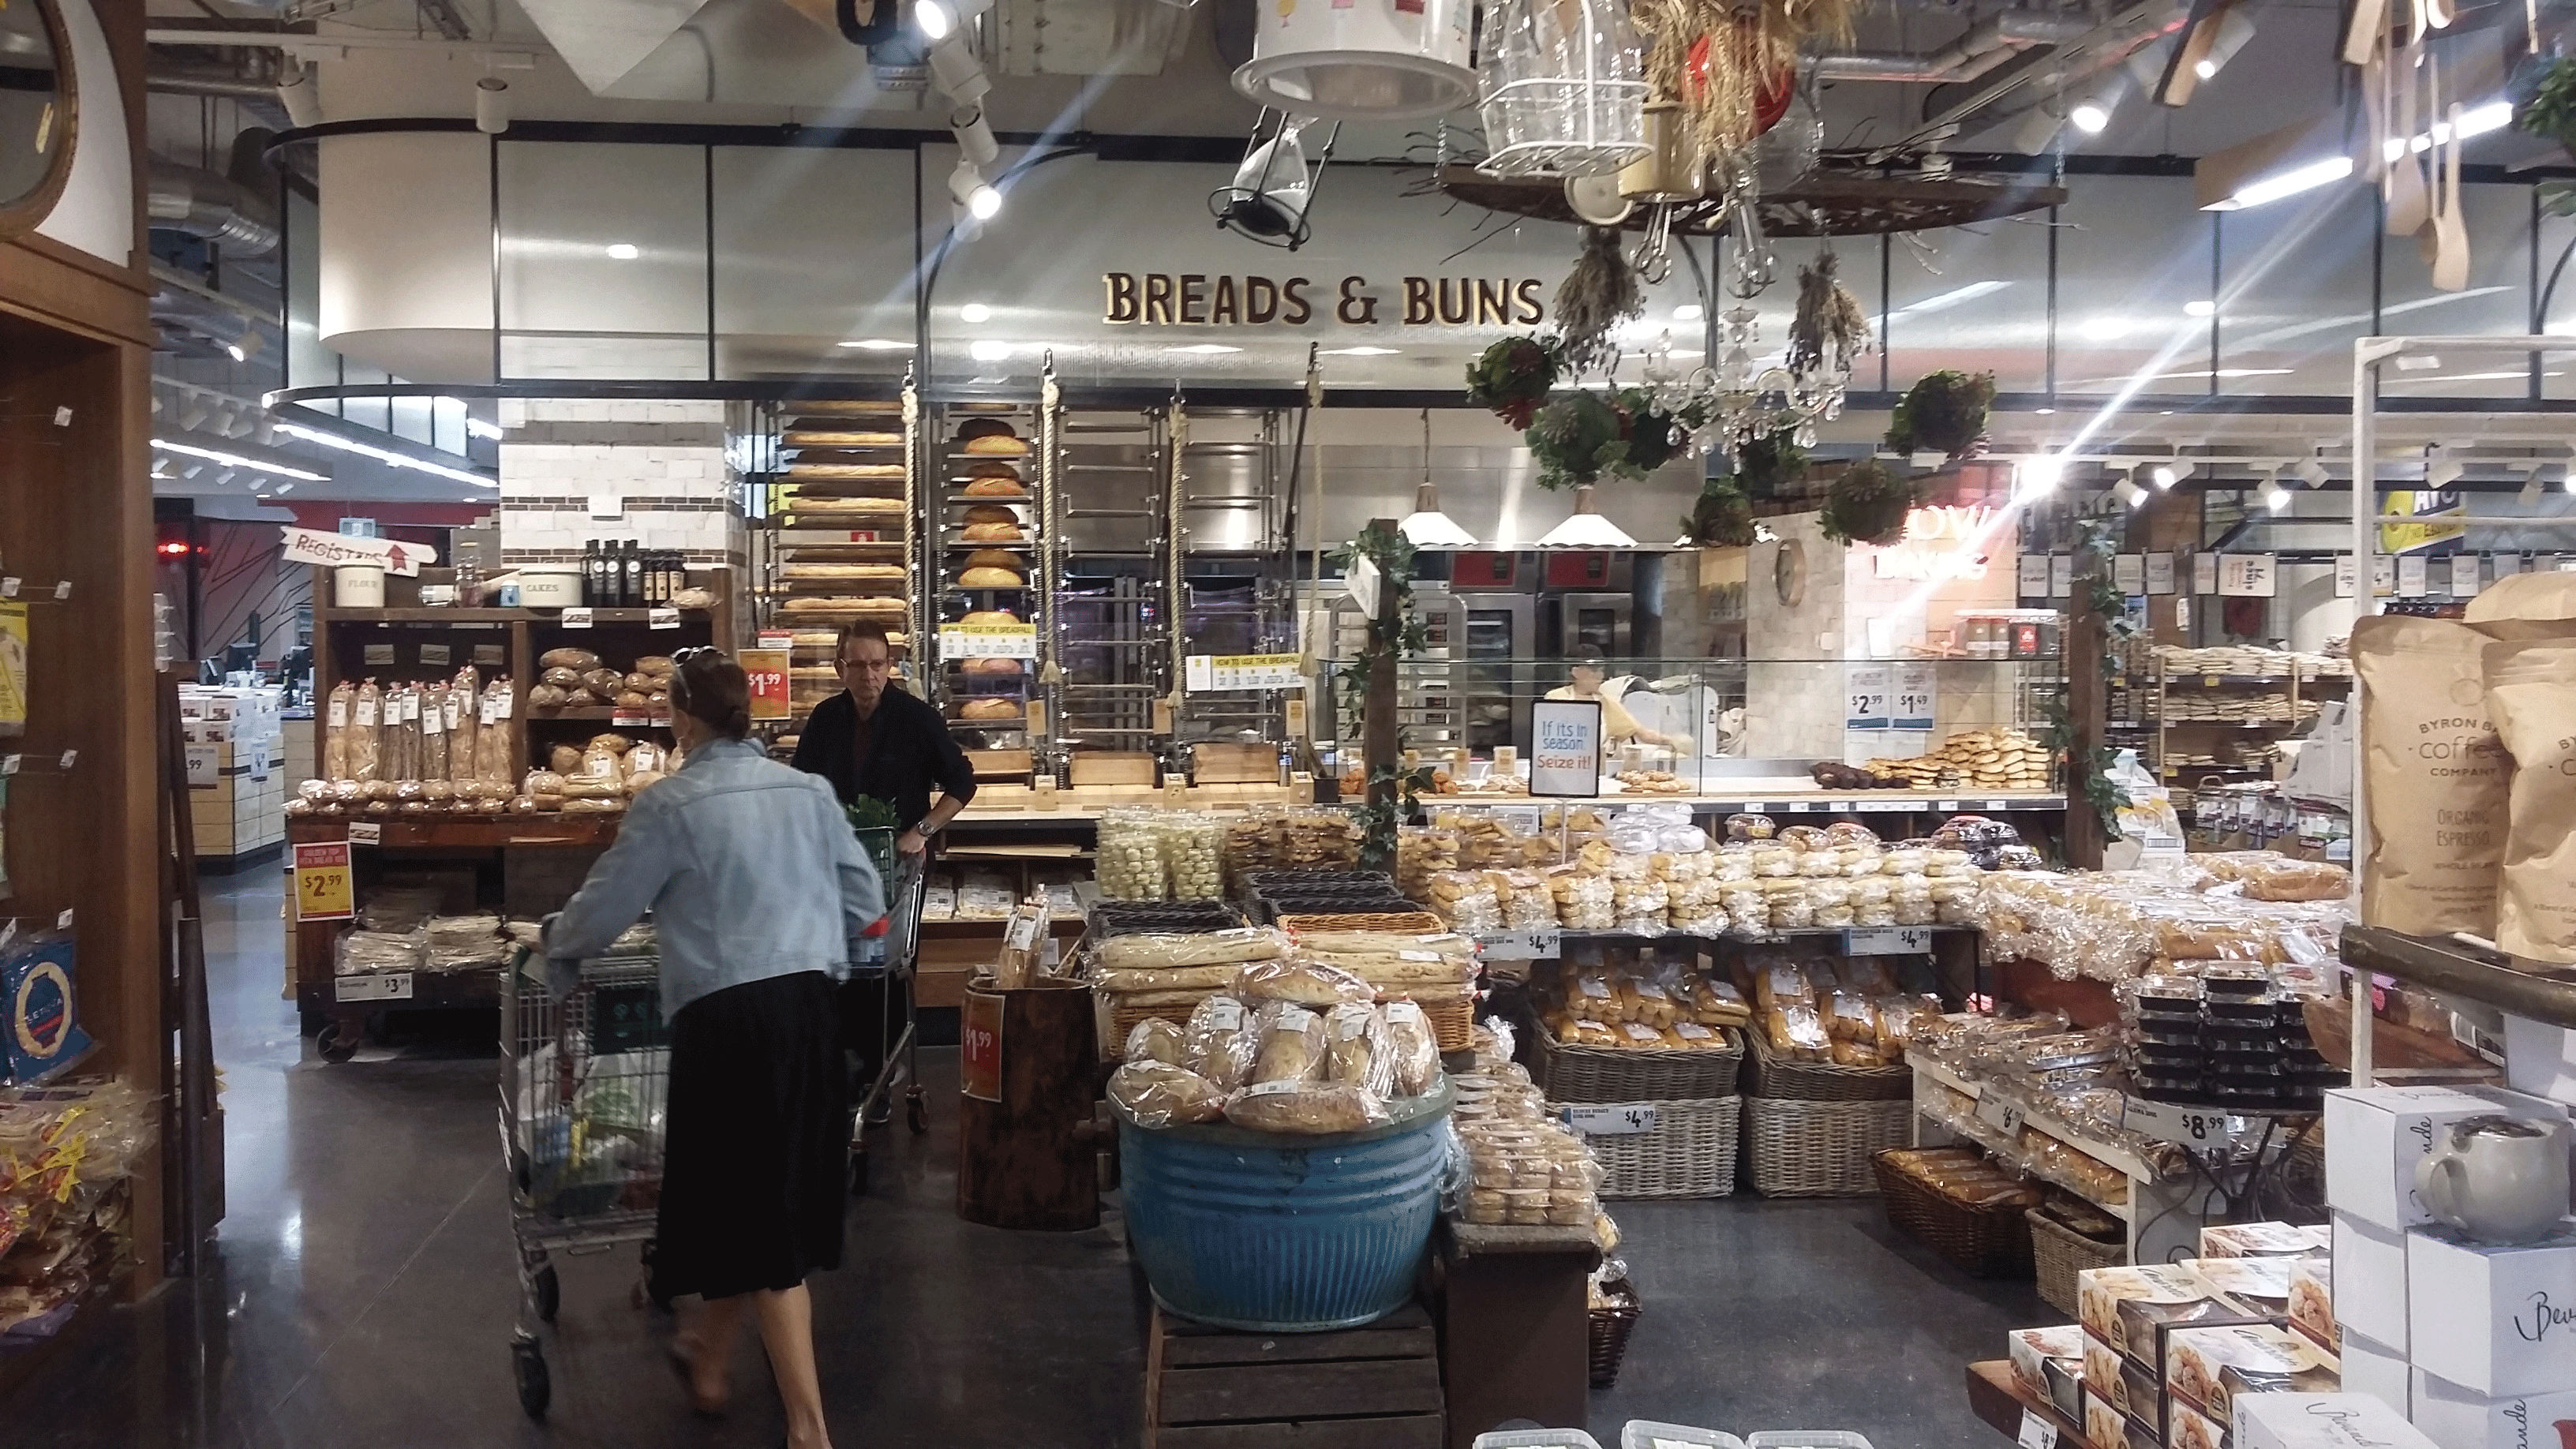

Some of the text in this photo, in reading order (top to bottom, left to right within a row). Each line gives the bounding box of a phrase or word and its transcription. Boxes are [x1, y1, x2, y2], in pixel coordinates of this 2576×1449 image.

[1103, 271, 1544, 327] BREADS & BUNS
[748, 672, 781, 696] $1.99
[1852, 695, 1883, 714] $2.99
[1900, 695, 1928, 714] $1.49
[1542, 721, 1554, 736] If
[2418, 717, 2477, 734] BYRON
[1537, 754, 1591, 769] Seize it!
[2430, 767, 2498, 777] COMPANY
[2436, 809, 2490, 826] ORGANIC
[2436, 829, 2491, 847] ESPRESSO
[305, 874, 343, 897] $2.99
[1529, 935, 1559, 953] $4.99
[1900, 930, 1930, 949] $4.99
[384, 978, 409, 993] $3.99
[965, 1027, 992, 1061] $1.99
[1625, 1110, 1654, 1128] $4.99
[2181, 1113, 2225, 1140] $8.99
[2514, 1291, 2576, 1342] Bev
